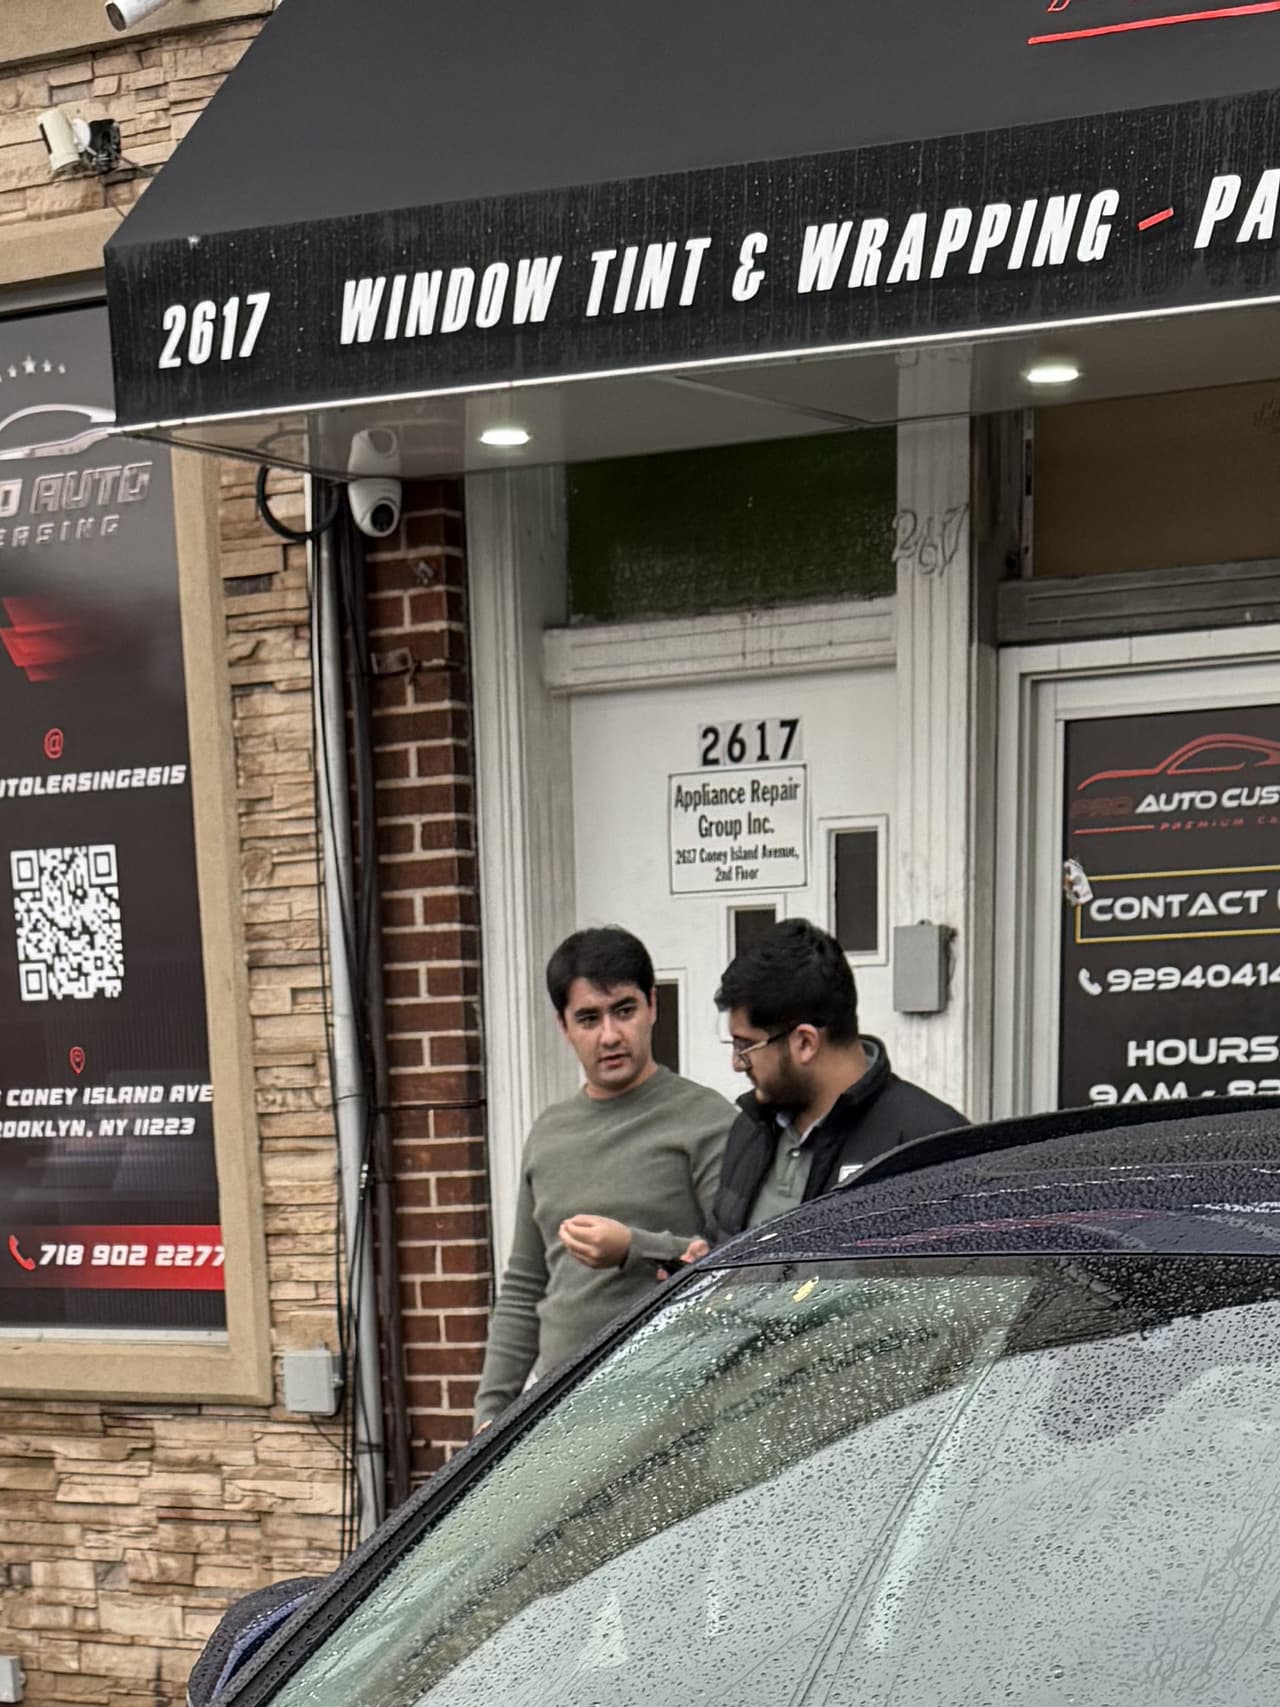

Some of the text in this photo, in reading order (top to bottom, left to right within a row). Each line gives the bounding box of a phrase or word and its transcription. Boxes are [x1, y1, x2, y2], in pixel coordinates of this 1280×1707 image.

[337, 255, 562, 347] WINDOW
[584, 236, 713, 317] TINT
[732, 231, 768, 300] &
[796, 189, 1120, 294] WRAPPING
[159, 292, 272, 369] 2617
[30, 461, 152, 514] AUTO
[701, 718, 800, 766] 2617
[674, 777, 800, 812] Appliance Repair
[1135, 788, 1218, 814] AUTO
[698, 811, 775, 840] Group Inc.
[1159, 817, 1245, 831] PREMIUM
[699, 847, 728, 865] Coney
[730, 844, 759, 861] Island
[715, 865, 759, 882] 2nd Floor
[1089, 890, 1268, 921] CONTACT
[6, 1088, 78, 1107] CONEY
[83, 1086, 162, 1105] ISLAND
[169, 1084, 214, 1102] AVE
[99, 1119, 128, 1137] NY
[133, 1117, 196, 1136] 11223
[38, 1245, 225, 1266] 718 902 2277
